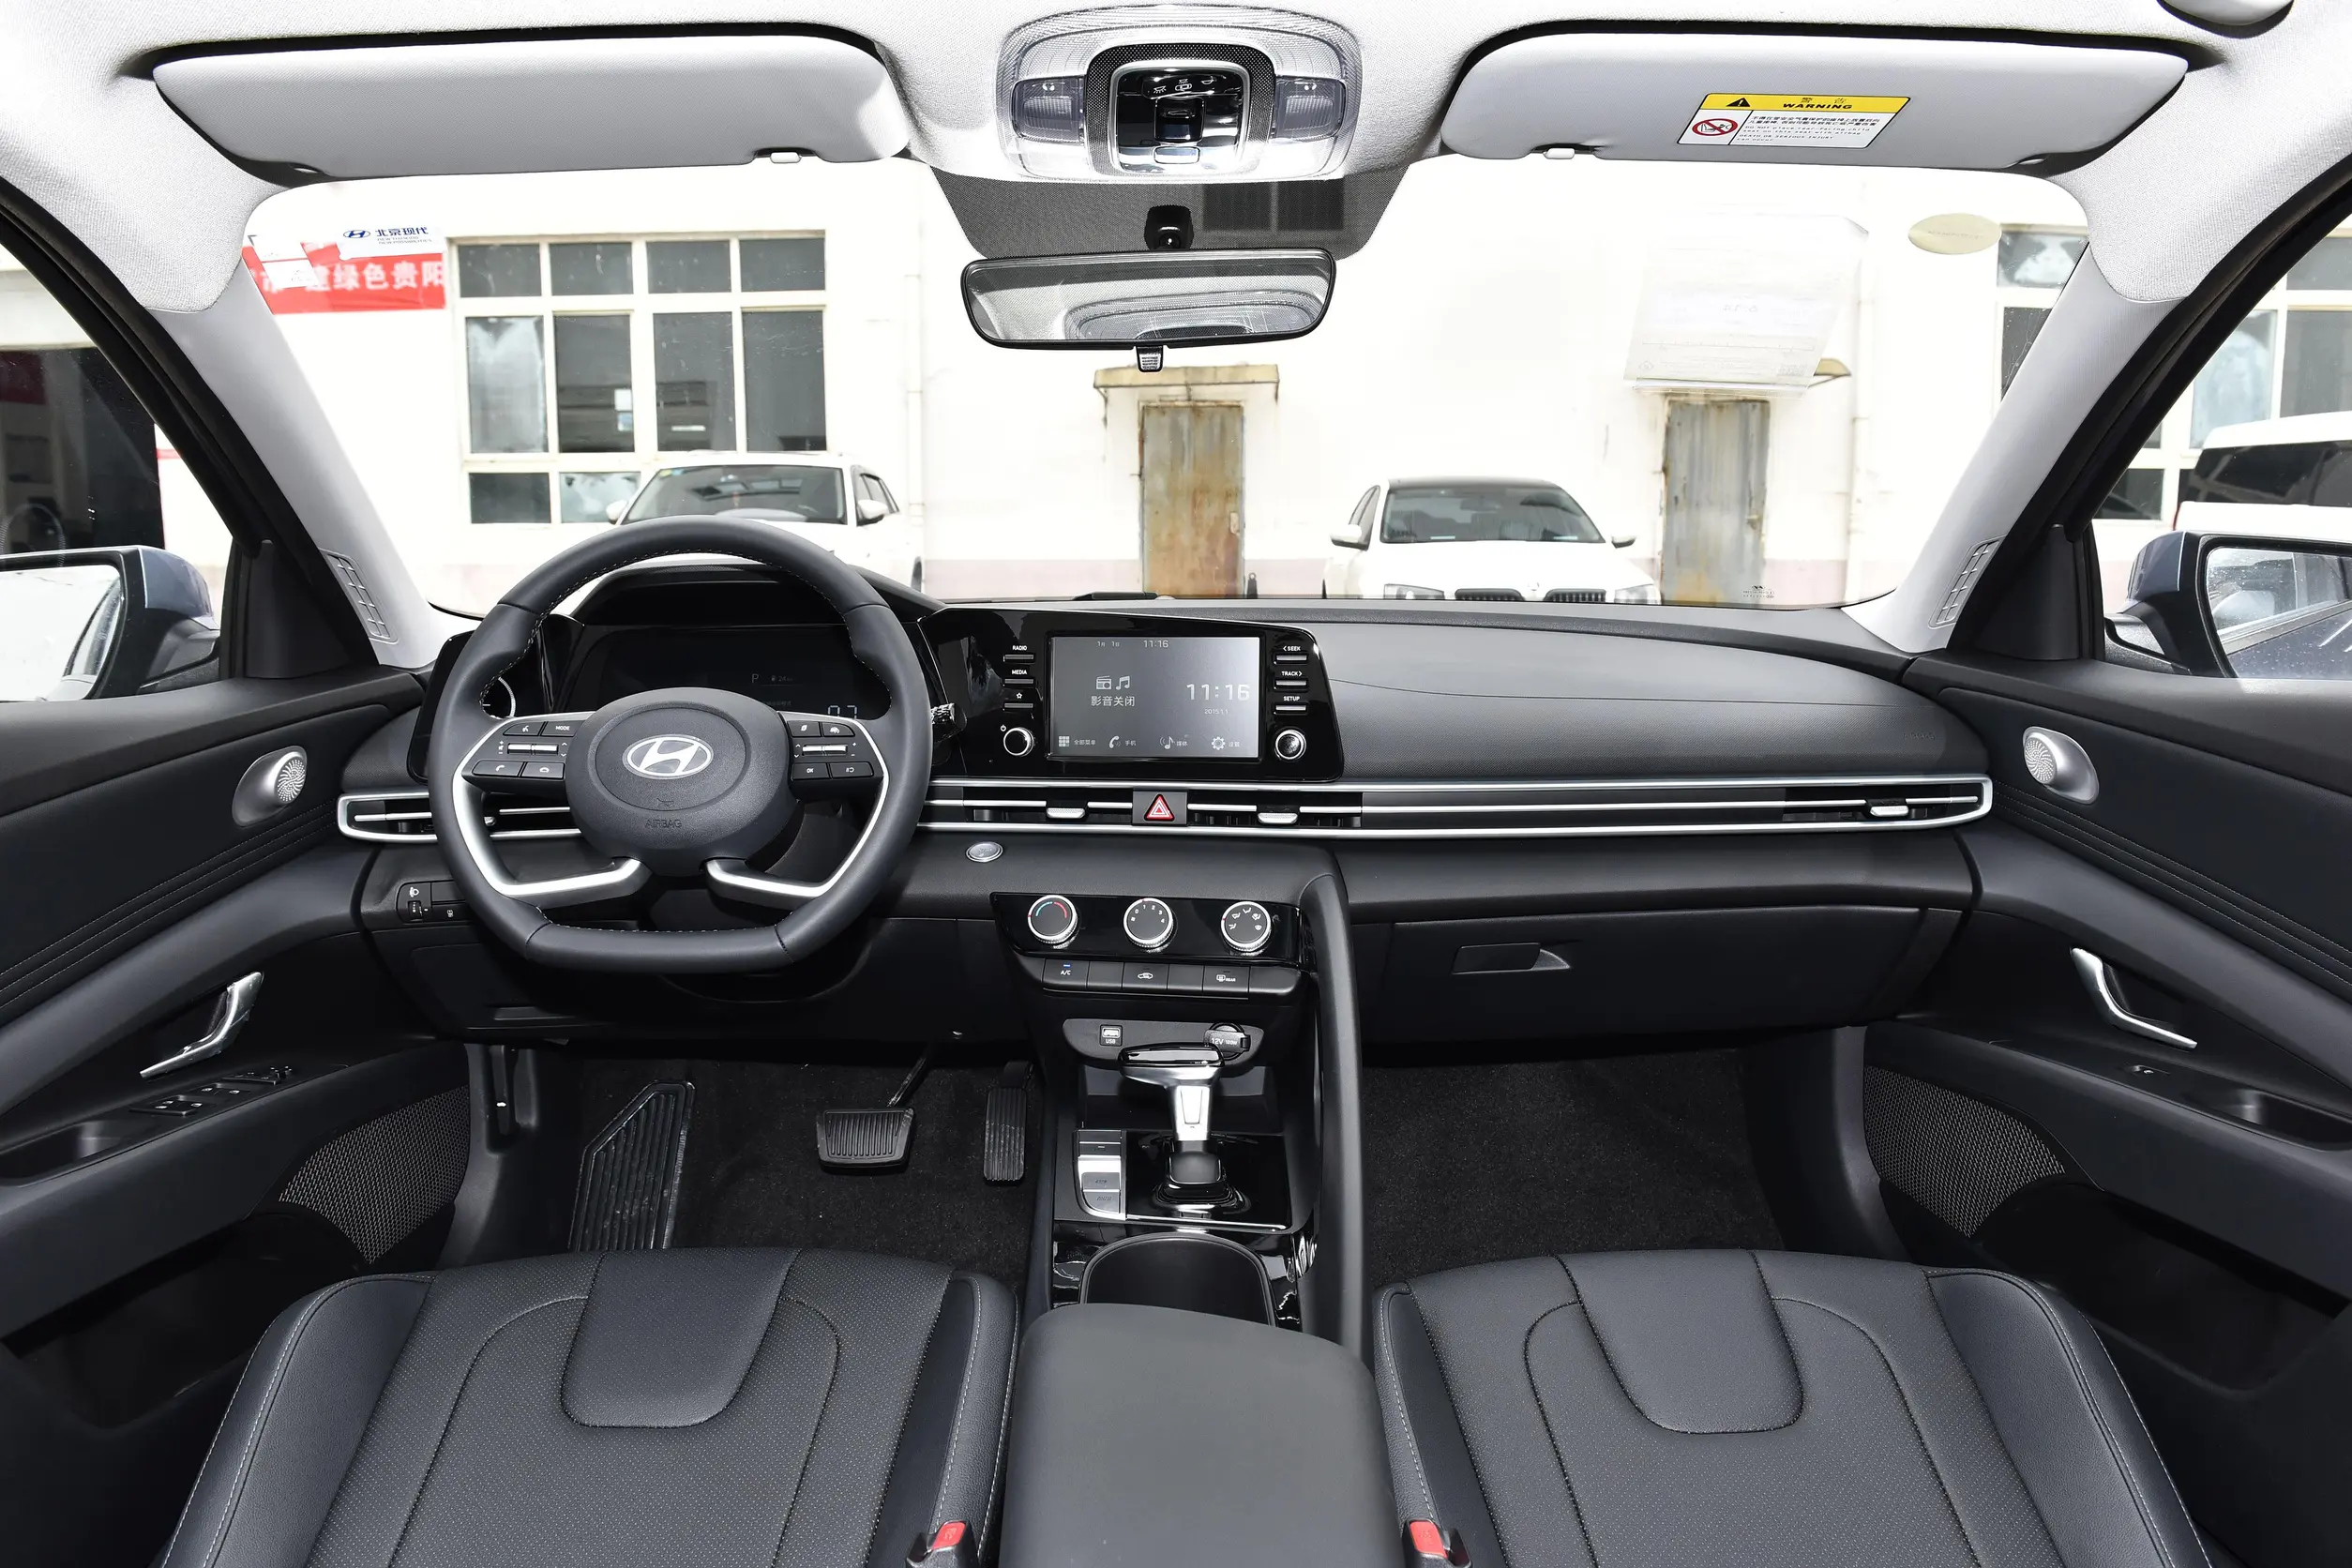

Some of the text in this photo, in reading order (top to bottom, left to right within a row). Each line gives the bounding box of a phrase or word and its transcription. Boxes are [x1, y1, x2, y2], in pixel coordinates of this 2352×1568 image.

[375, 227, 429, 236] 北京现代
[1186, 684, 1250, 701] 11:16
[1091, 695, 1136, 707] 影音关闭
[645, 819, 683, 828] AIRBAG
